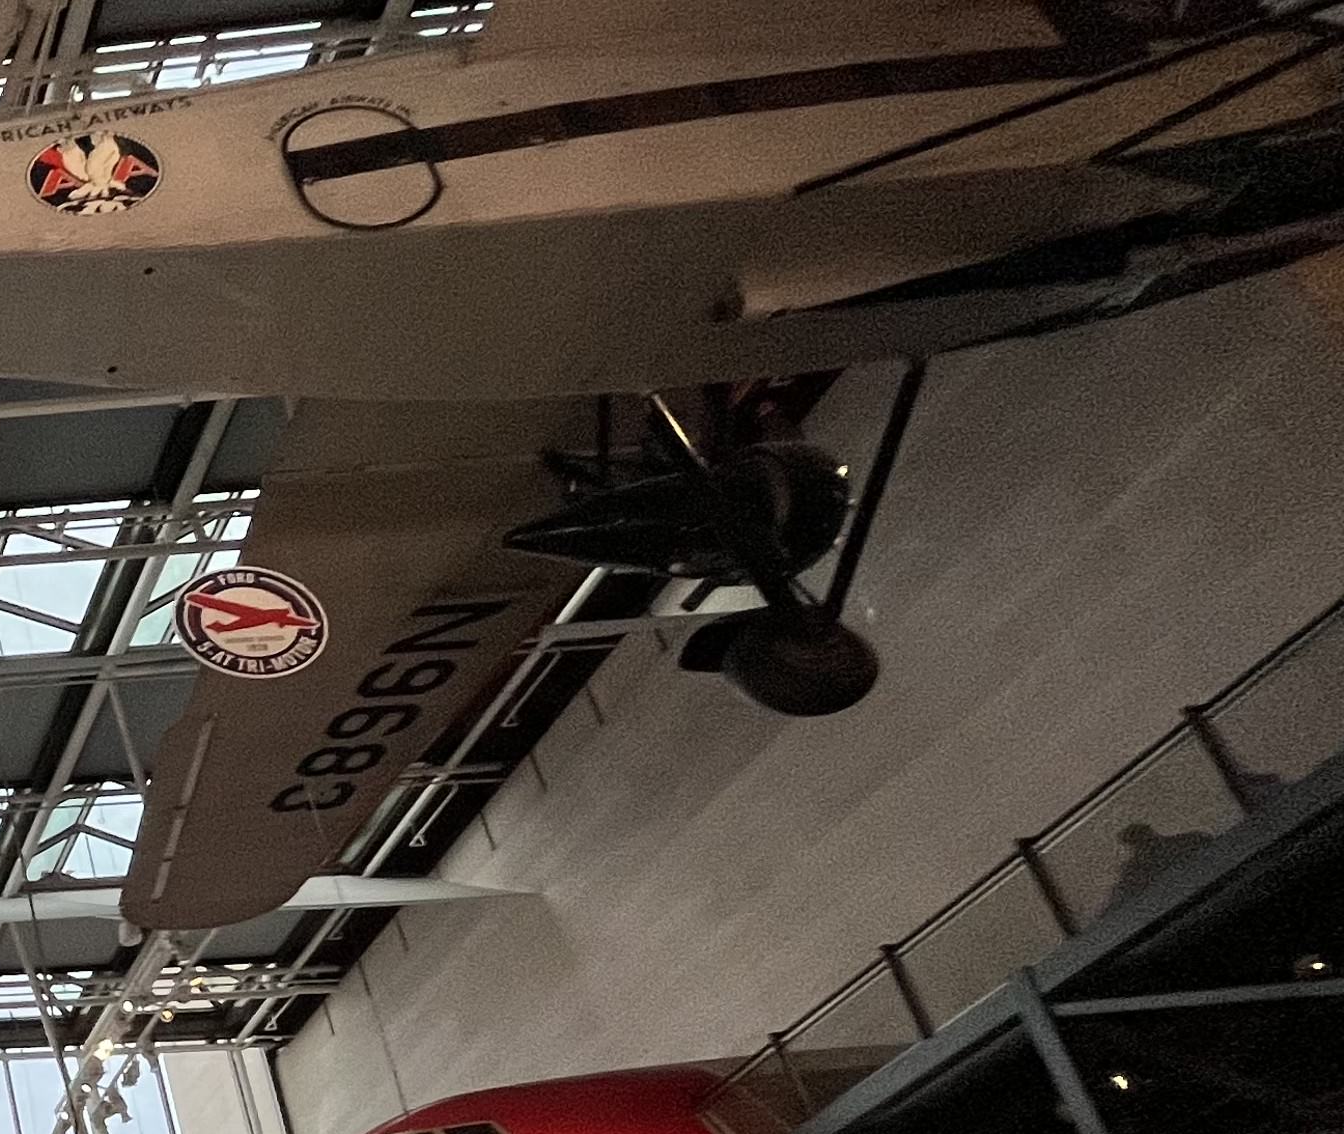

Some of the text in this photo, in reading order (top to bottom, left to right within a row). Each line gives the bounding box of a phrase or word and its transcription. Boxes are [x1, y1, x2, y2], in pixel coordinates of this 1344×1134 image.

[86, 96, 193, 128] AIRWAYS
[217, 573, 255, 586] FORD
[236, 635, 318, 673] TRI-MOTOR
[269, 600, 511, 813] N9683
